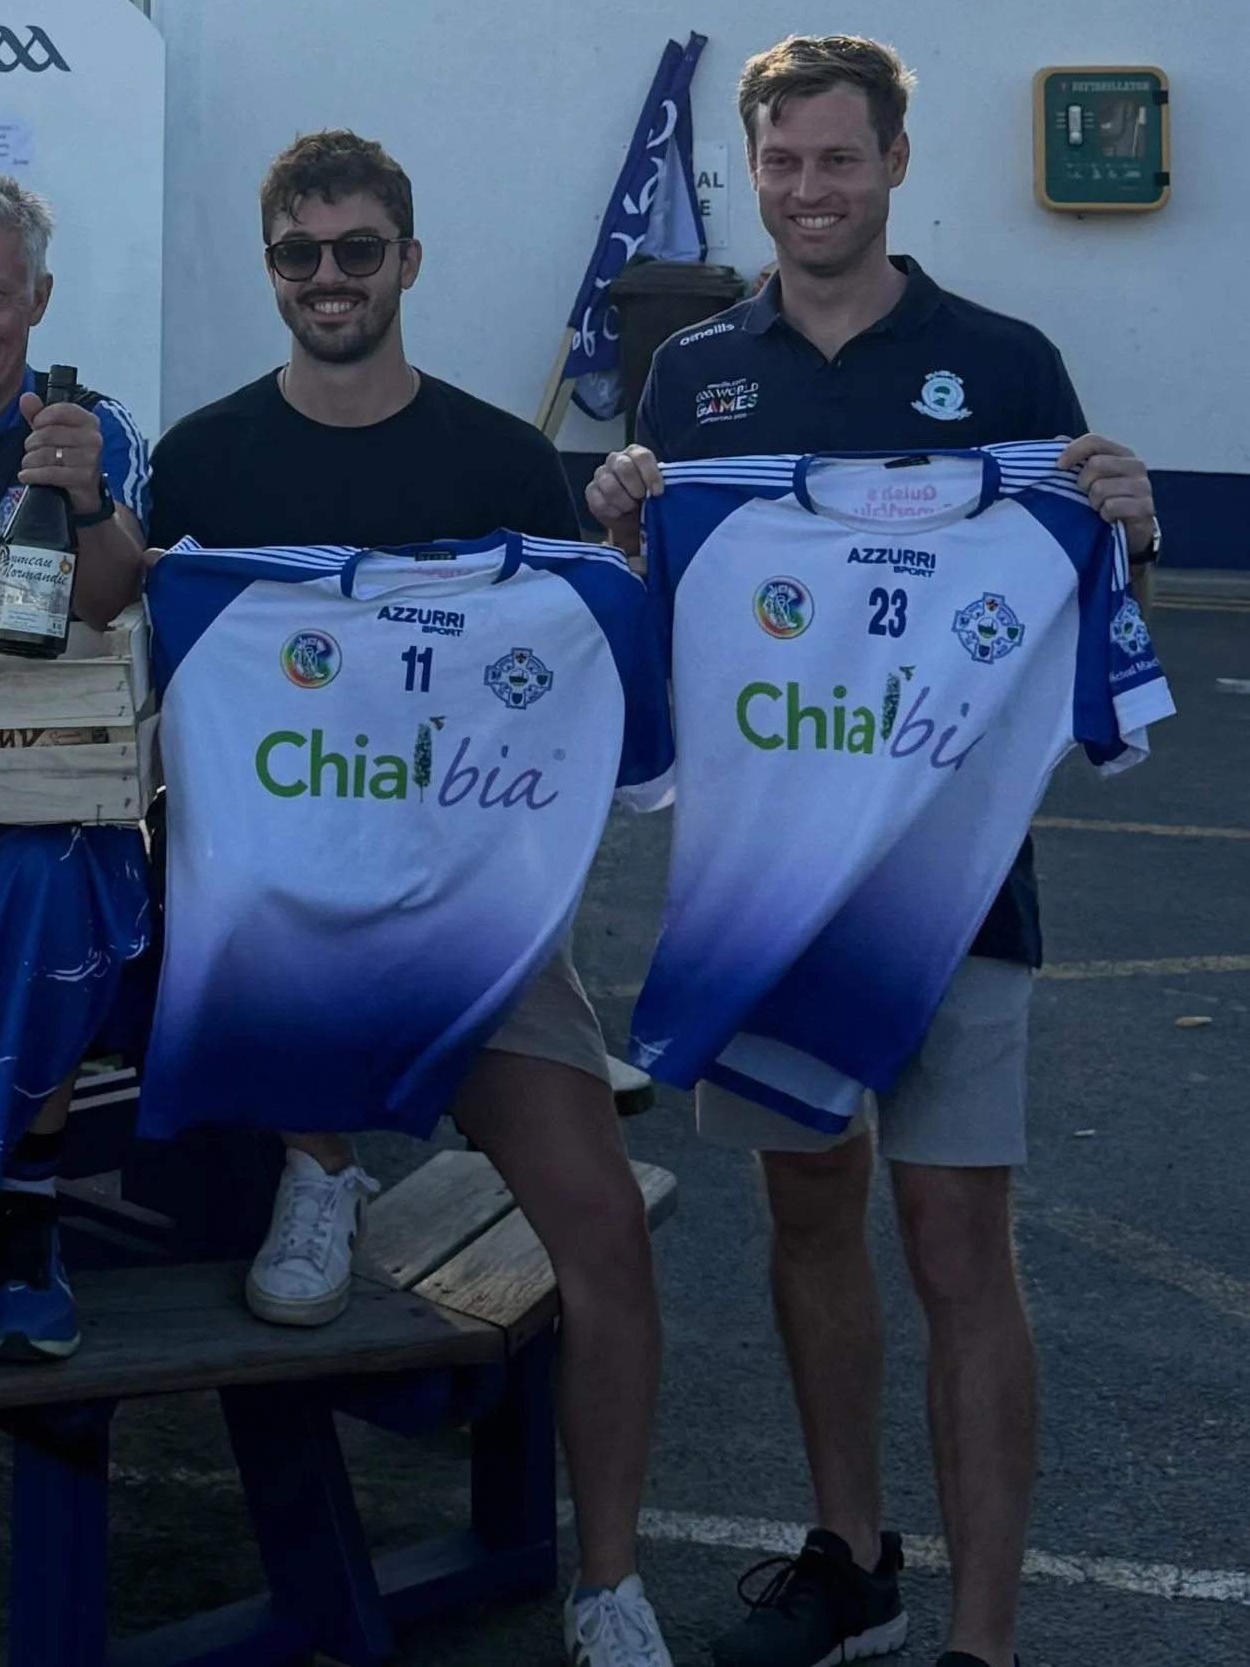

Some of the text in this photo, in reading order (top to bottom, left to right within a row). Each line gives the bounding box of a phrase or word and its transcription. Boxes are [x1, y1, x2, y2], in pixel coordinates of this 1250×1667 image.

[696, 393, 758, 418] GAMES
[847, 547, 937, 569] AZZURRI
[893, 566, 935, 578] SPORT
[377, 606, 465, 629] AZZURRI
[868, 587, 908, 638] 23
[422, 626, 464, 637] SPORT
[401, 645, 433, 693] 11
[736, 681, 876, 754] Chia
[255, 729, 559, 810] Chia bia
